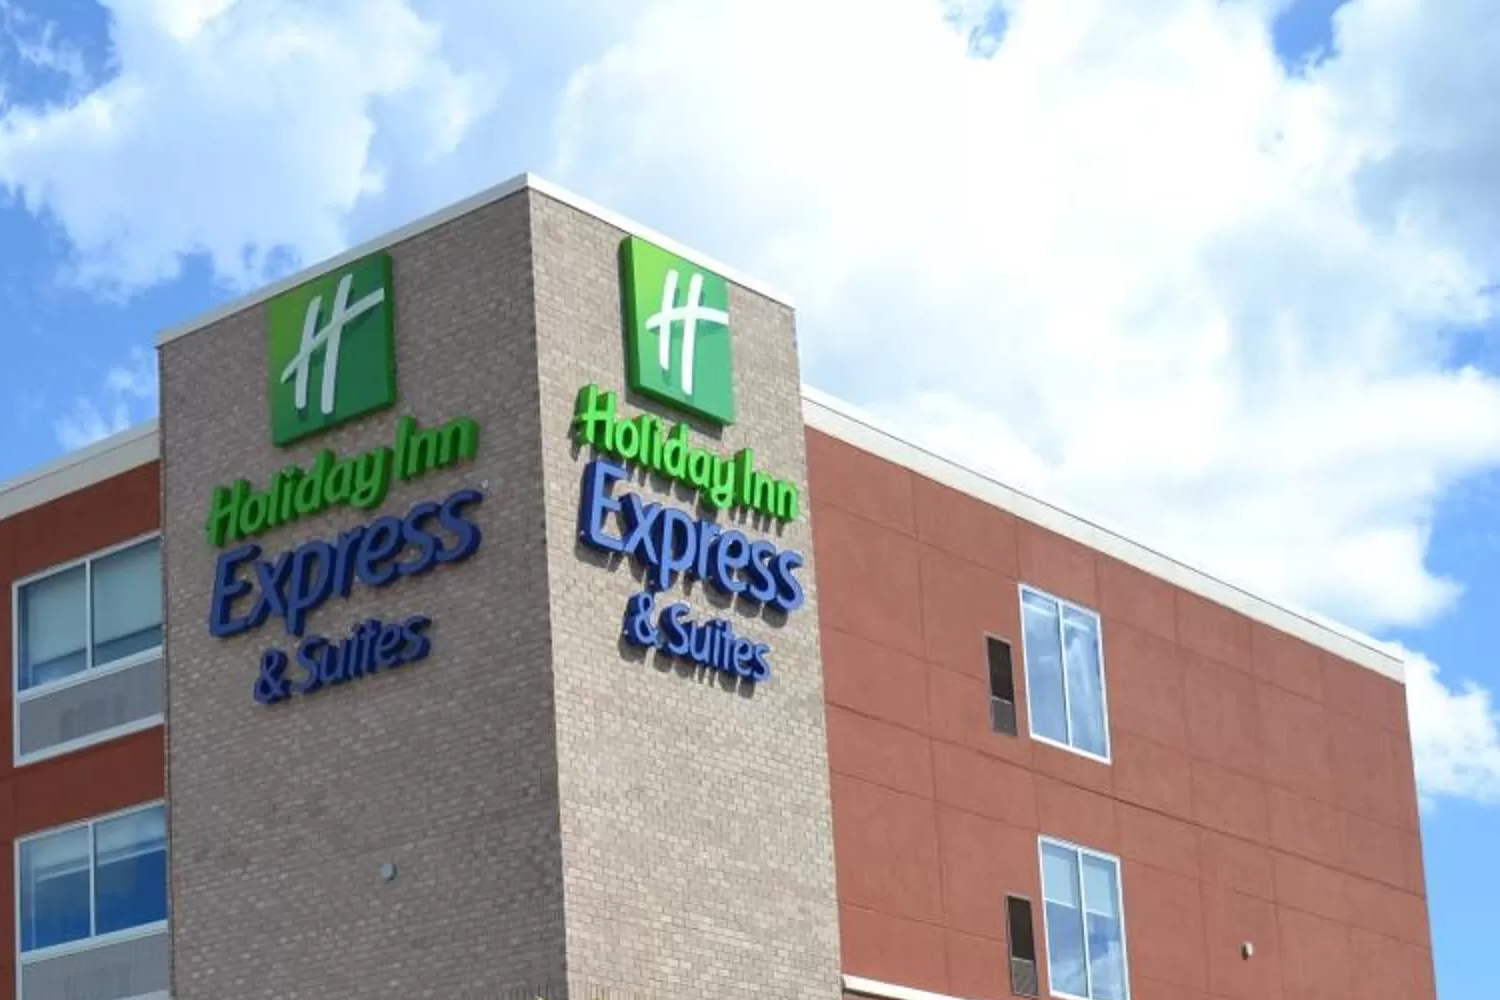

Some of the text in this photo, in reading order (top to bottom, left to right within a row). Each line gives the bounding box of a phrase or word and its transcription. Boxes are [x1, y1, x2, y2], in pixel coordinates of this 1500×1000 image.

[207, 416, 480, 546] Holiday Inn
[575, 384, 799, 522] Holiday Inn
[209, 490, 484, 639] Express
[579, 459, 805, 613] Express
[253, 614, 433, 704] & Suites
[622, 592, 773, 683] & Suites
